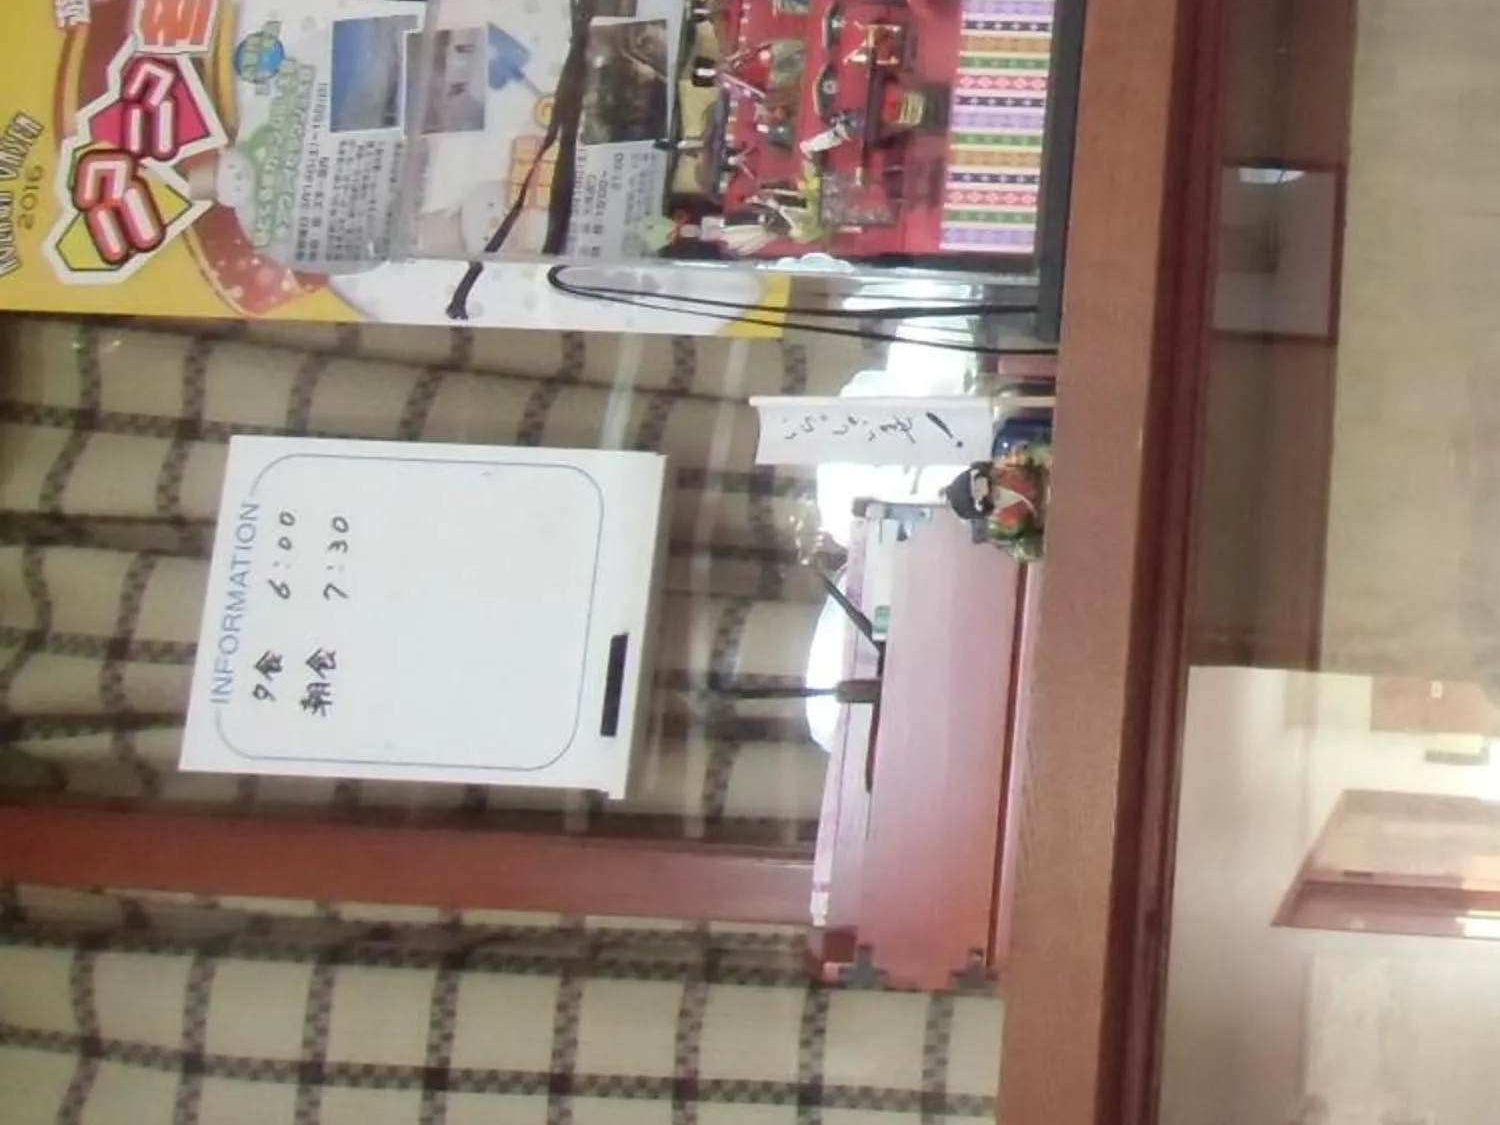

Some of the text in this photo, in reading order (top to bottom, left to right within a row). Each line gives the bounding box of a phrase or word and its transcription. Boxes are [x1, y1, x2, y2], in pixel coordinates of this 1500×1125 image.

[209, 501, 260, 705] INFORMATION
[300, 515, 349, 718] 朝食 7:30
